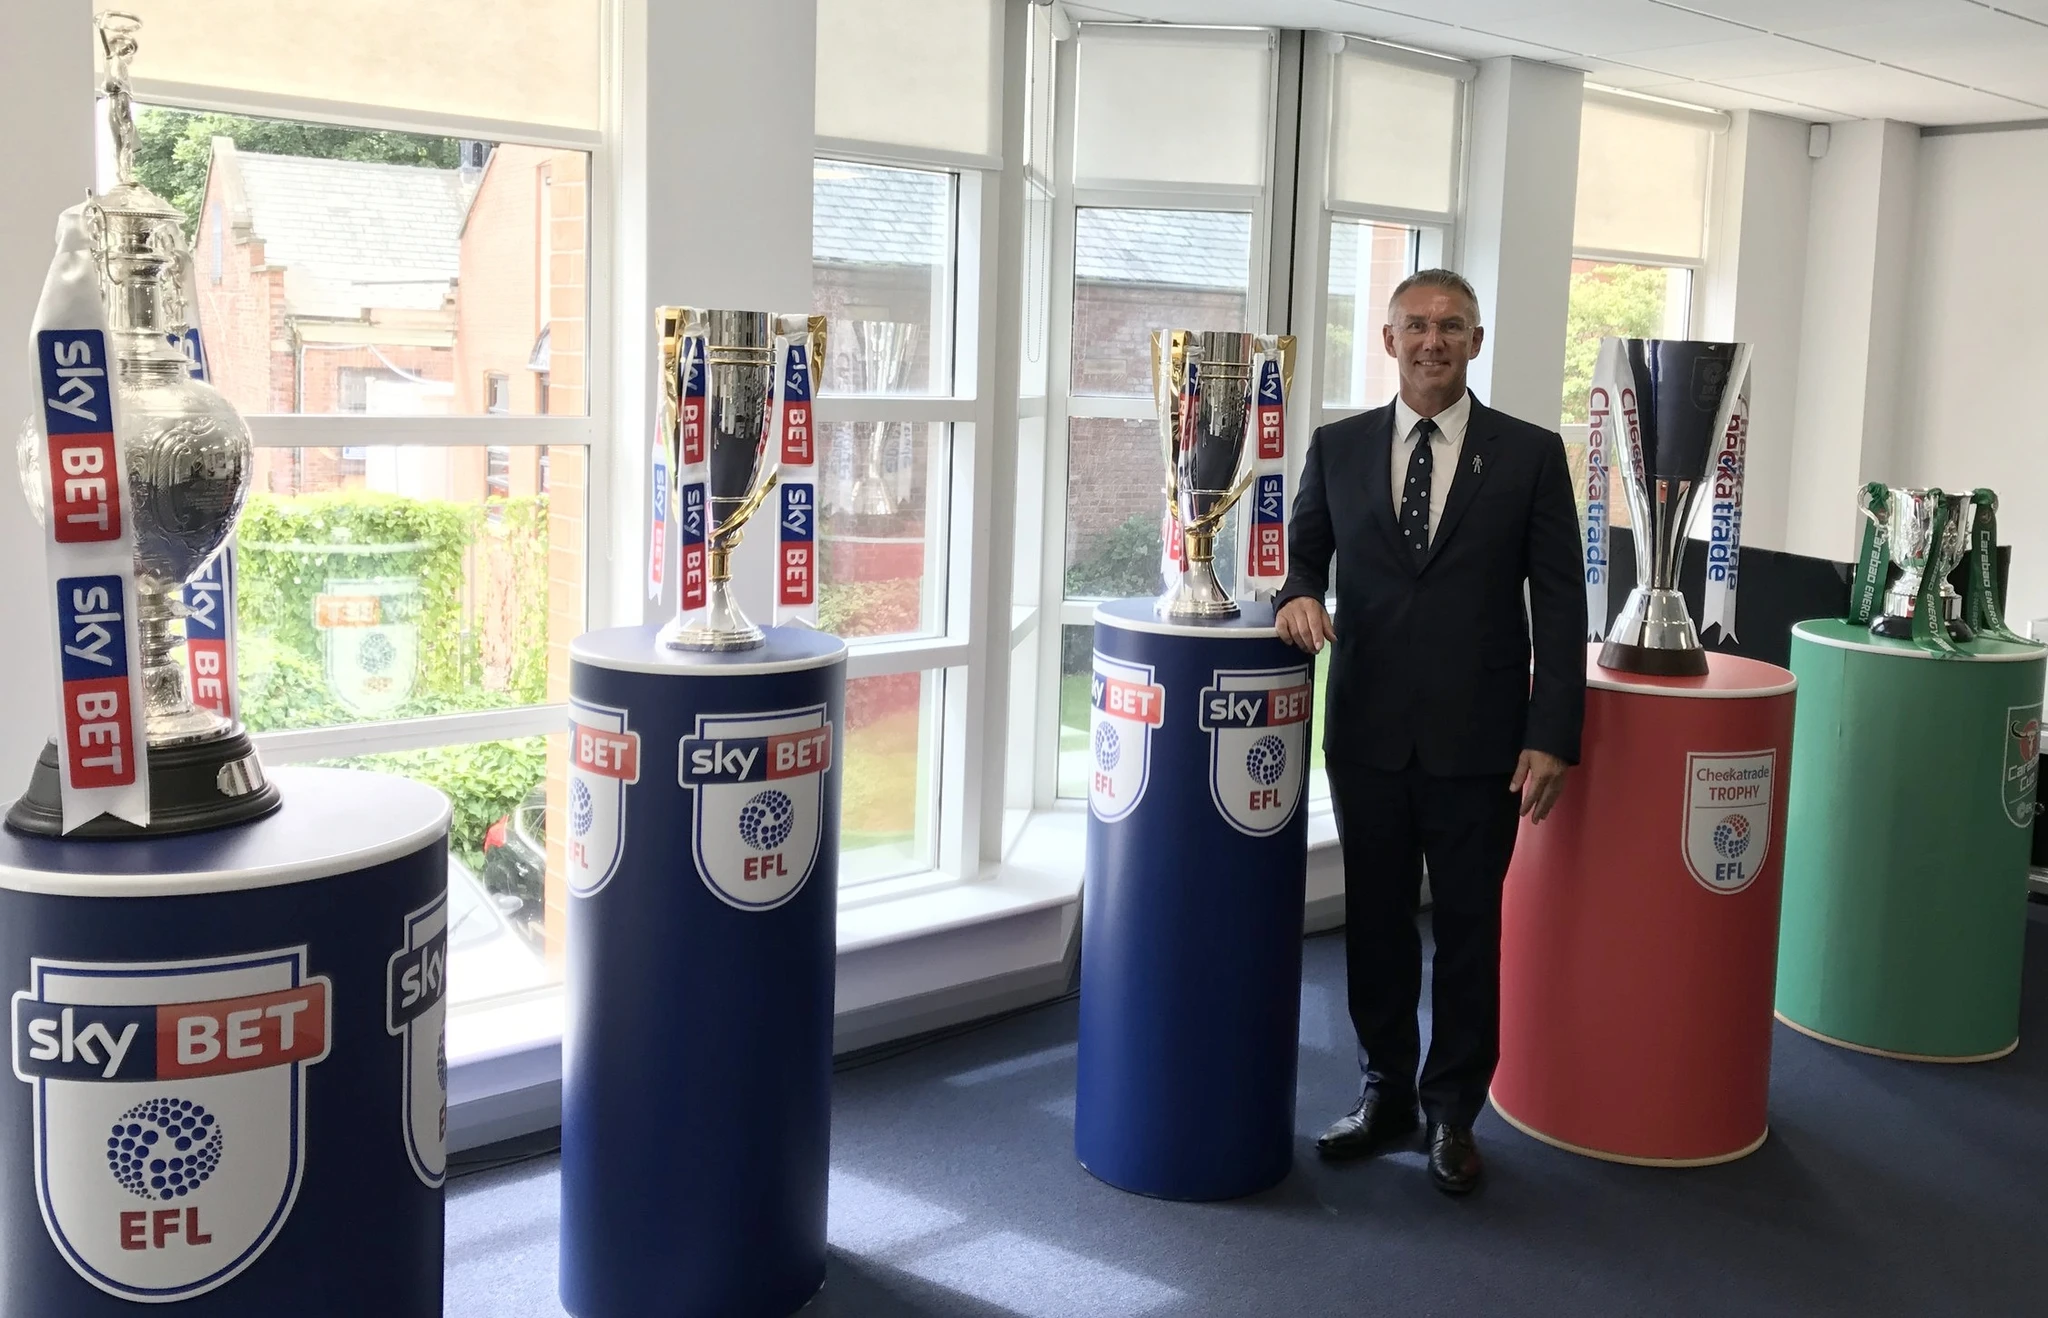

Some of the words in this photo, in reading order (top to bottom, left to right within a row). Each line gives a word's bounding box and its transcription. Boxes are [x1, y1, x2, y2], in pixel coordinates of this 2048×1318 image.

[48, 340, 104, 423] sky
[684, 404, 698, 456] BET
[787, 408, 808, 458] BET
[1262, 411, 1280, 453] BET
[61, 446, 108, 531] BET
[655, 469, 666, 517] sky
[1259, 479, 1283, 518] sky
[684, 489, 704, 537] sky
[782, 489, 812, 536] sky
[786, 549, 807, 598] BET
[1262, 529, 1280, 574] BET
[1980, 530, 1992, 588] Carabao
[687, 551, 702, 601] BET
[65, 585, 122, 667] sky
[1859, 585, 1875, 623] ENERGY
[1926, 593, 1940, 637] ENERGY
[1984, 590, 2001, 630] ENERGY
[1110, 684, 1155, 717] BET
[1210, 693, 1263, 727] sky
[1274, 690, 1309, 720] BET
[76, 691, 123, 775] BET
[580, 733, 629, 771] BET
[691, 741, 760, 782] sky
[775, 734, 827, 772] BET
[1095, 771, 1116, 798] EFL
[1249, 788, 1282, 811] EFL
[1709, 785, 1760, 801] TROPHY
[743, 853, 788, 882] EFL
[1715, 861, 1745, 881] EFL
[28, 1007, 140, 1079] sky
[176, 999, 309, 1066] BET
[119, 1206, 213, 1251] EFL
